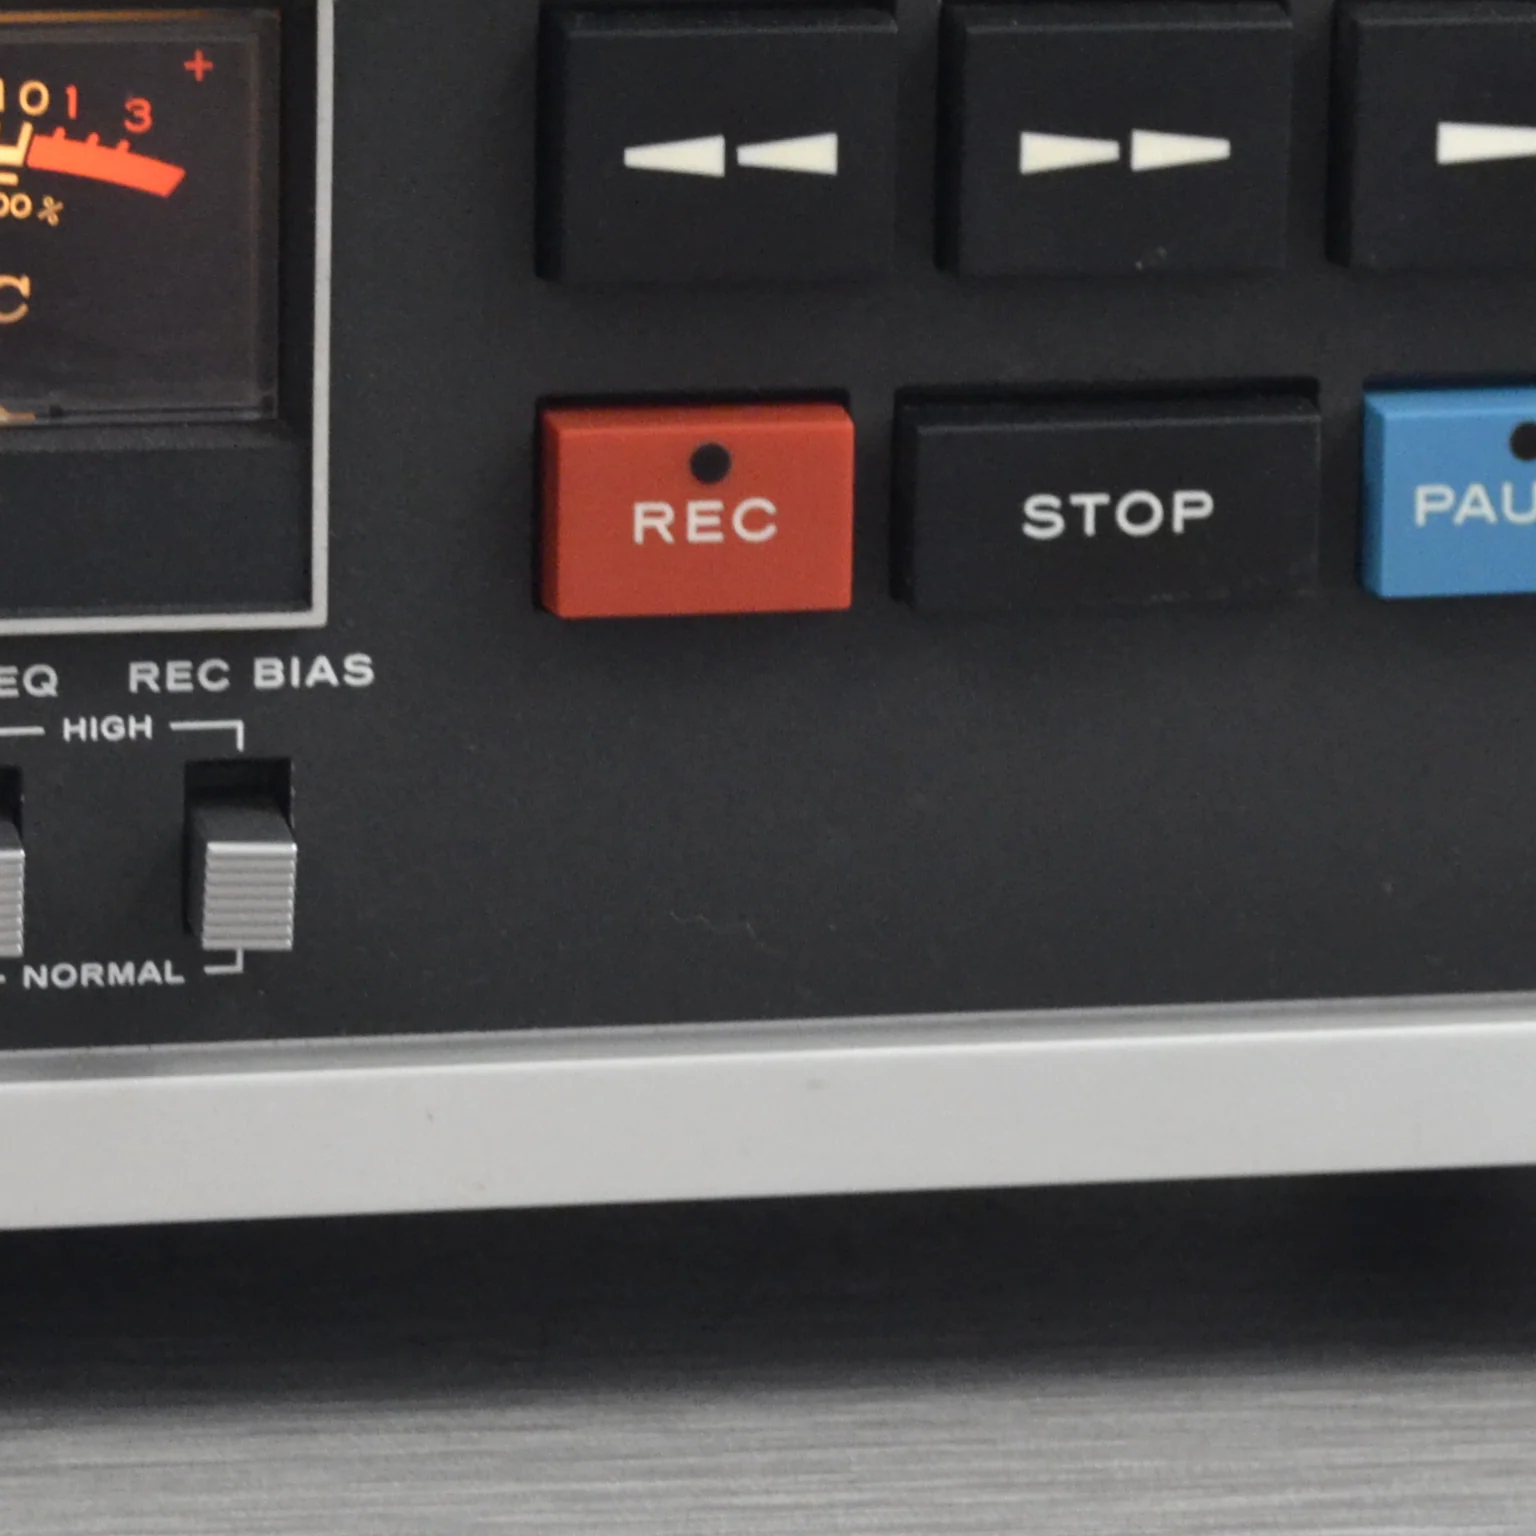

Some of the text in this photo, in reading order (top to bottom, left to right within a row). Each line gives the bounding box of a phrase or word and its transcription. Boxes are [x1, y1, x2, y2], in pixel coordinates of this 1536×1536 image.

[18, 80, 50, 116] 0
[65, 84, 78, 120] 1
[123, 97, 153, 134] 3
[633, 496, 777, 545] REC
[1022, 489, 1214, 540] STOP
[128, 652, 375, 694] REC BIAS
[62, 714, 153, 742] HIGH
[22, 959, 185, 989] NORMAL
